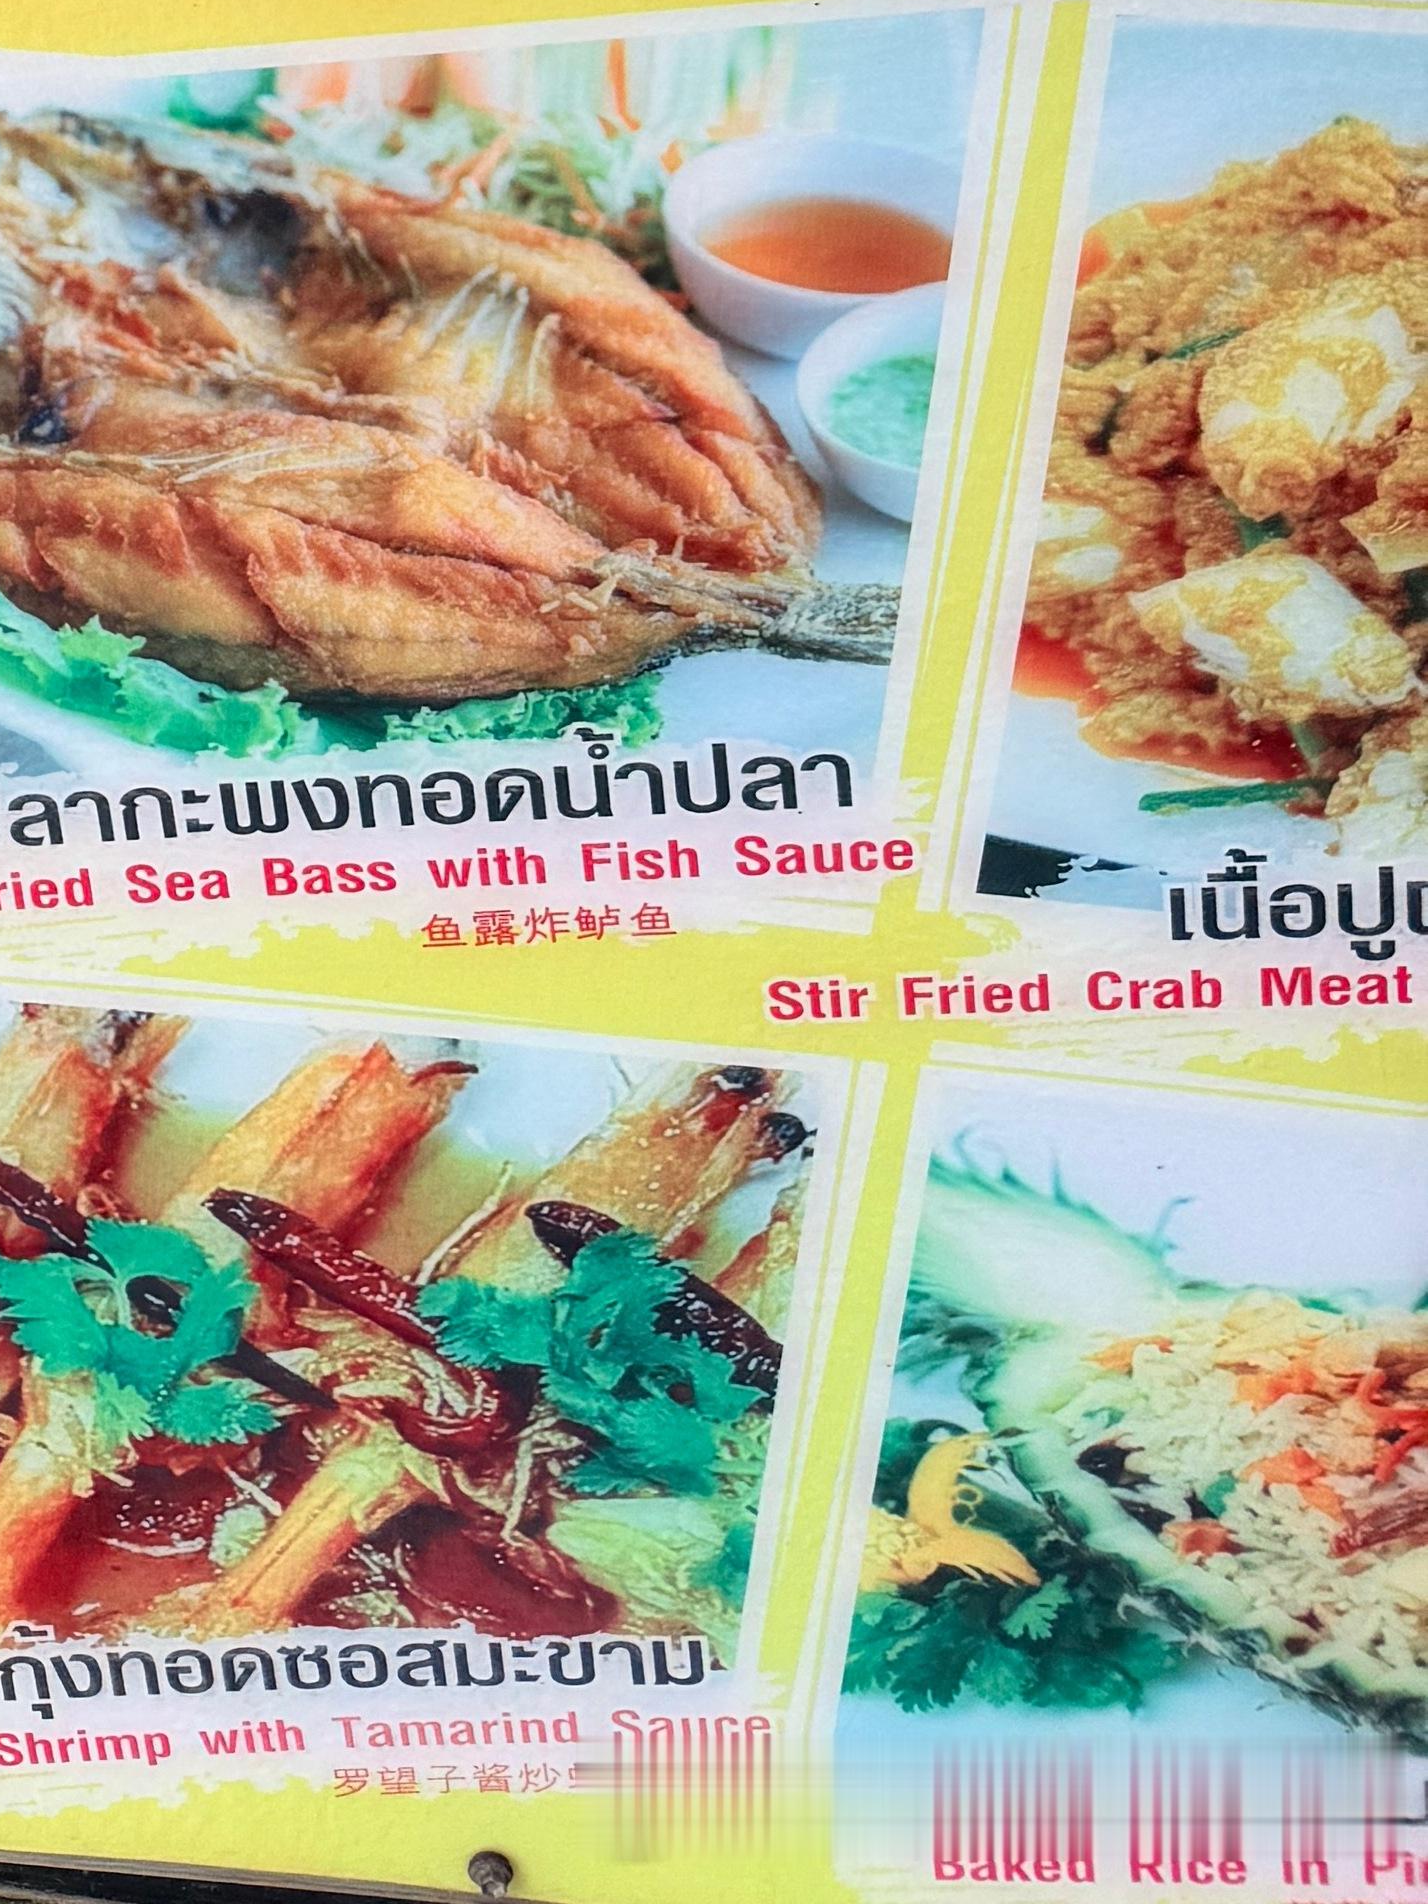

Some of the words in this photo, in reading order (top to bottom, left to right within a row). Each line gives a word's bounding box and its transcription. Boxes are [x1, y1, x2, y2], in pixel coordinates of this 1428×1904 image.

[125, 864, 229, 904] Sea
[263, 858, 397, 896] Bass
[428, 847, 546, 889] with
[581, 840, 699, 881] Fish
[734, 836, 913, 876] Sauce
[422, 901, 677, 950] 鱼露炸鲈鱼
[768, 980, 868, 1020] Stir
[903, 974, 1050, 1016] Fried
[1087, 969, 1223, 1011] Crab
[1260, 966, 1411, 1007] Meat
[201, 1720, 304, 1755] with
[331, 1712, 579, 1752] Tamarind
